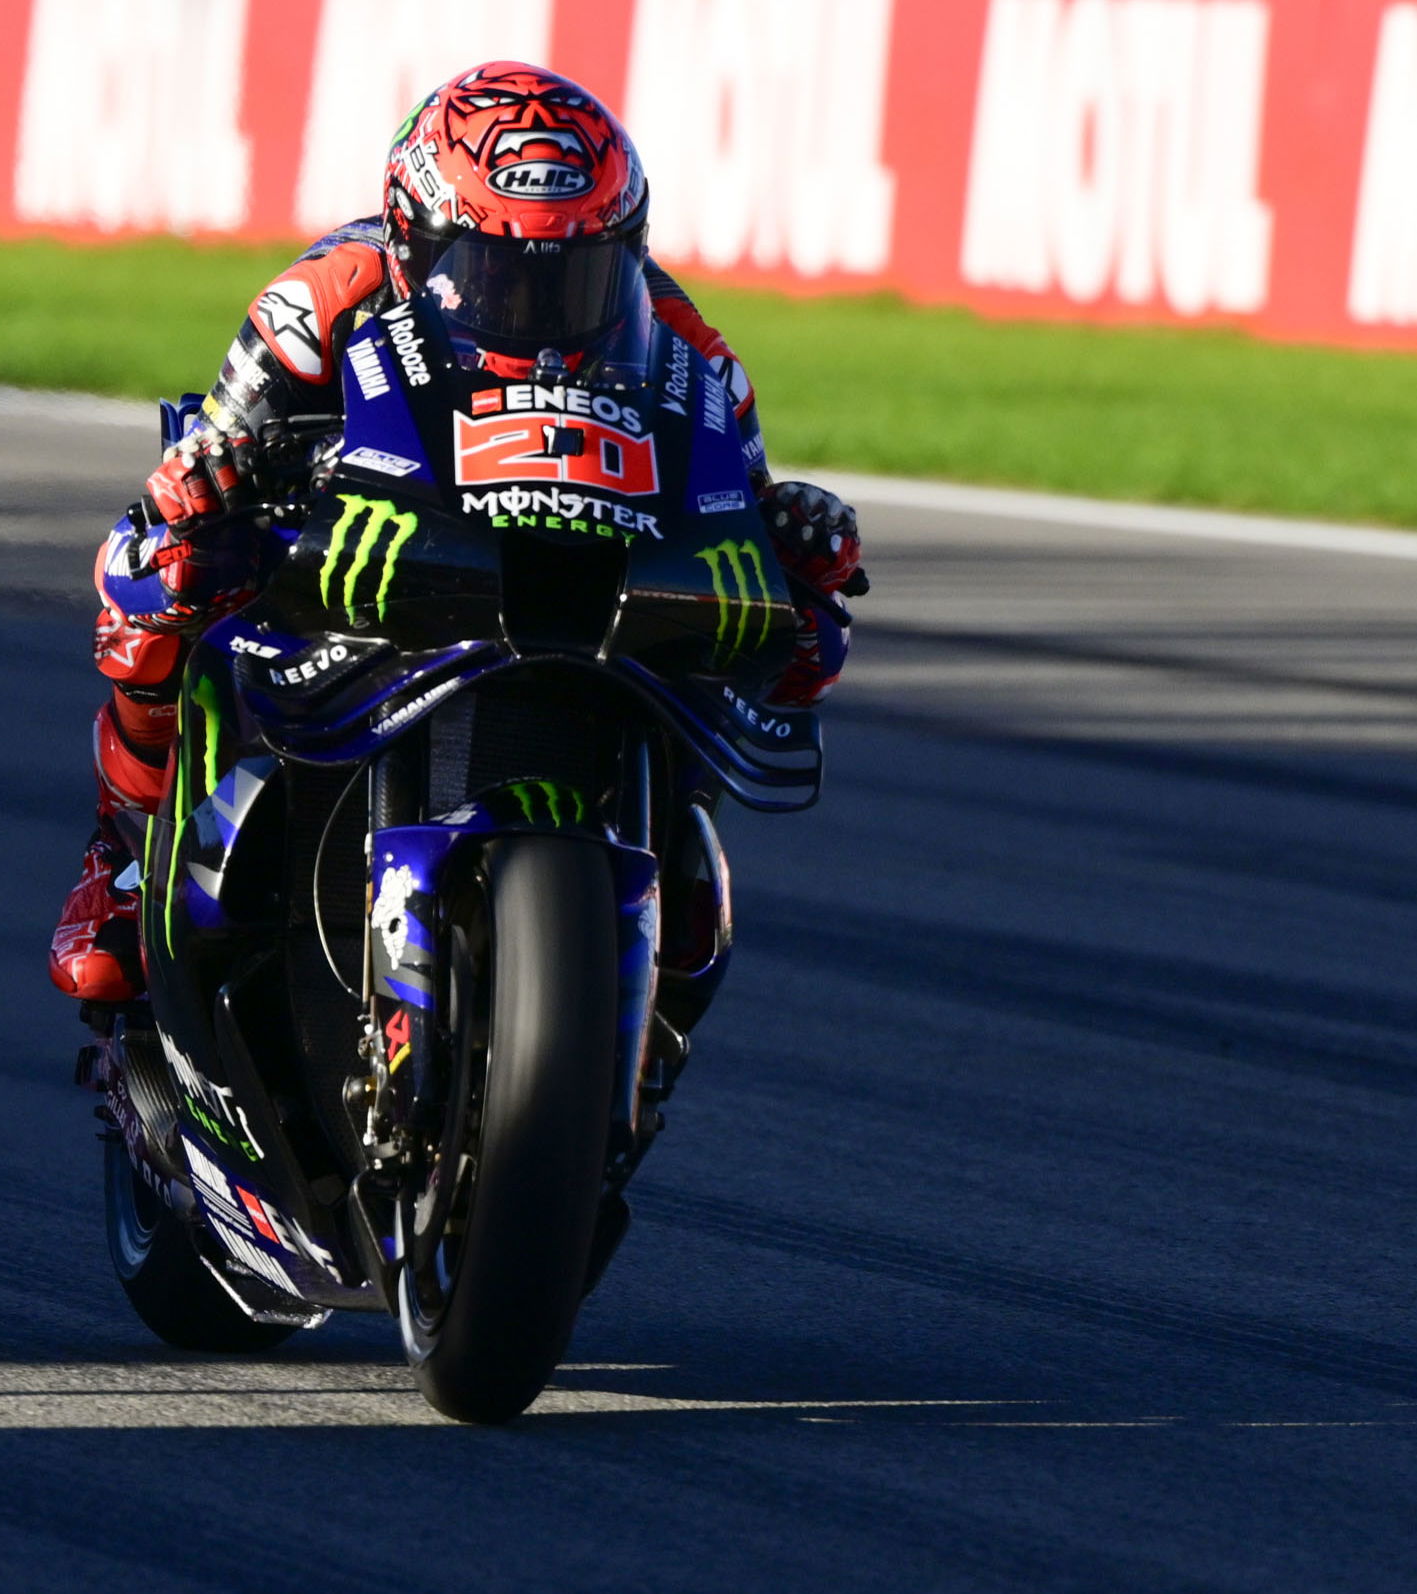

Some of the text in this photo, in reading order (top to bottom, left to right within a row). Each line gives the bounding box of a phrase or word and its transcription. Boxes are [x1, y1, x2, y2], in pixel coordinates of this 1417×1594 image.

[503, 170, 580, 188] HJC
[347, 337, 390, 400] YAMAHA
[388, 318, 431, 387] Roboze
[665, 336, 689, 400] Roboze
[506, 385, 642, 433] ENEOS
[704, 373, 726, 434] YAMAHA
[453, 410, 660, 496] 20
[462, 486, 664, 539] MONSTER
[492, 515, 636, 547] ENERGY
[269, 644, 348, 686] REEJO
[723, 686, 791, 738] REEJO
